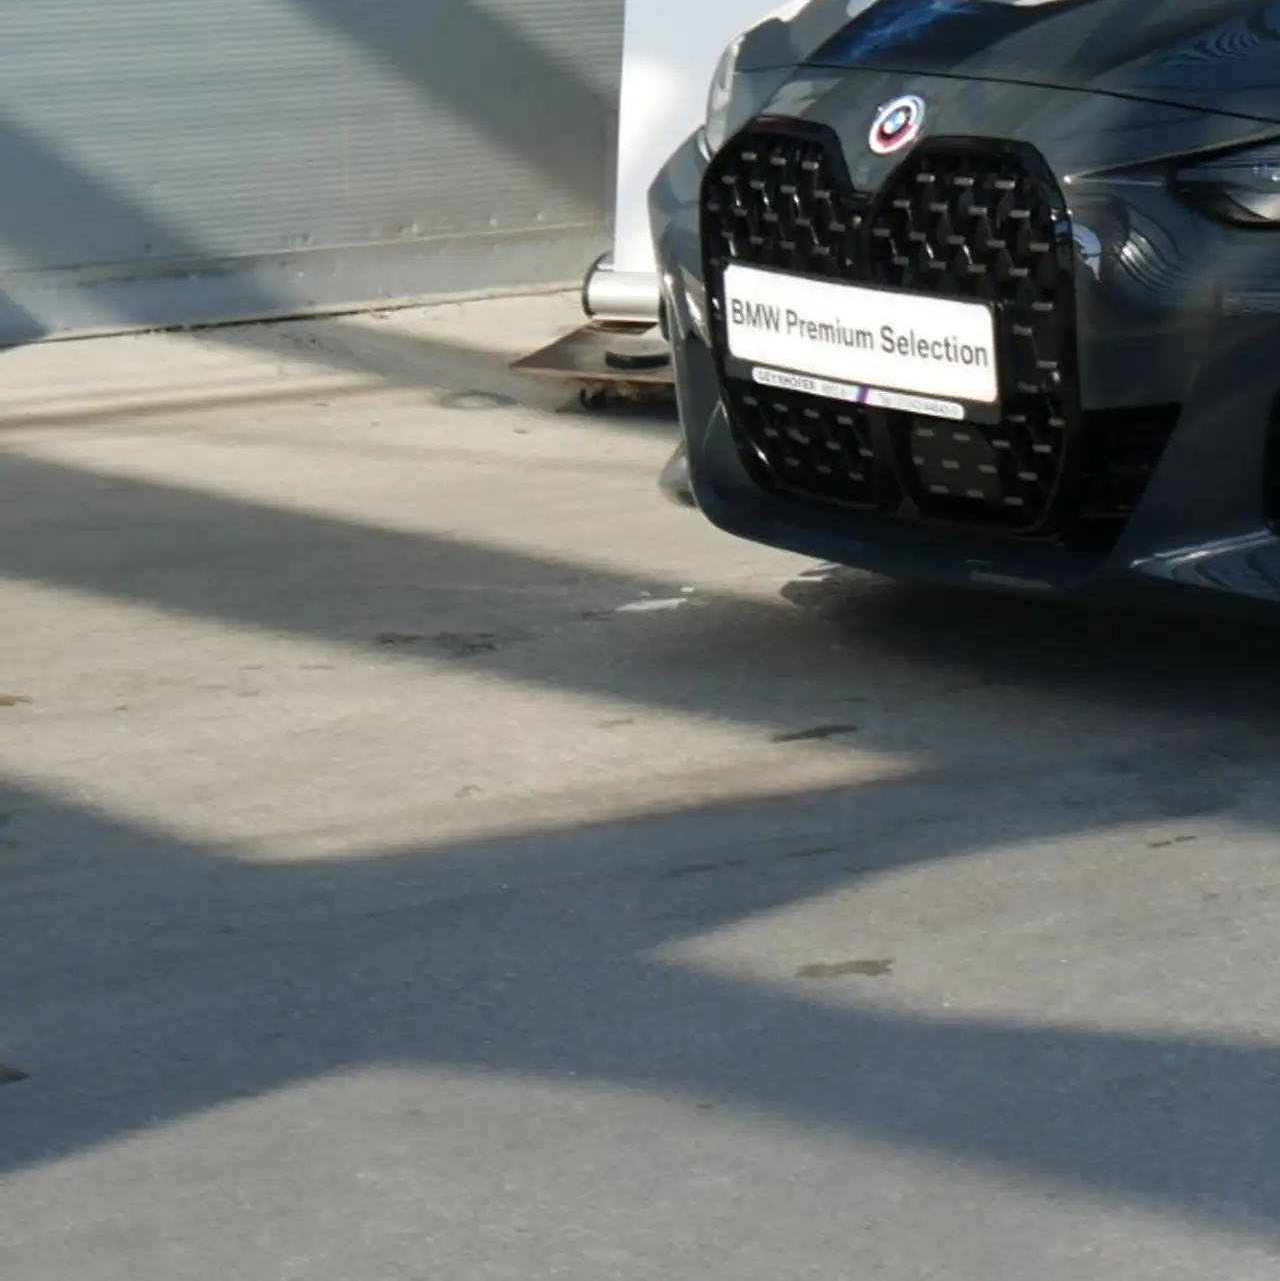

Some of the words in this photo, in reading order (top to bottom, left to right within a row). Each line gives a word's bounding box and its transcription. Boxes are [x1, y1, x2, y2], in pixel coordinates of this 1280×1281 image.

[731, 297, 781, 334] BMW
[786, 308, 875, 352] Premium
[879, 324, 989, 368] Selection
